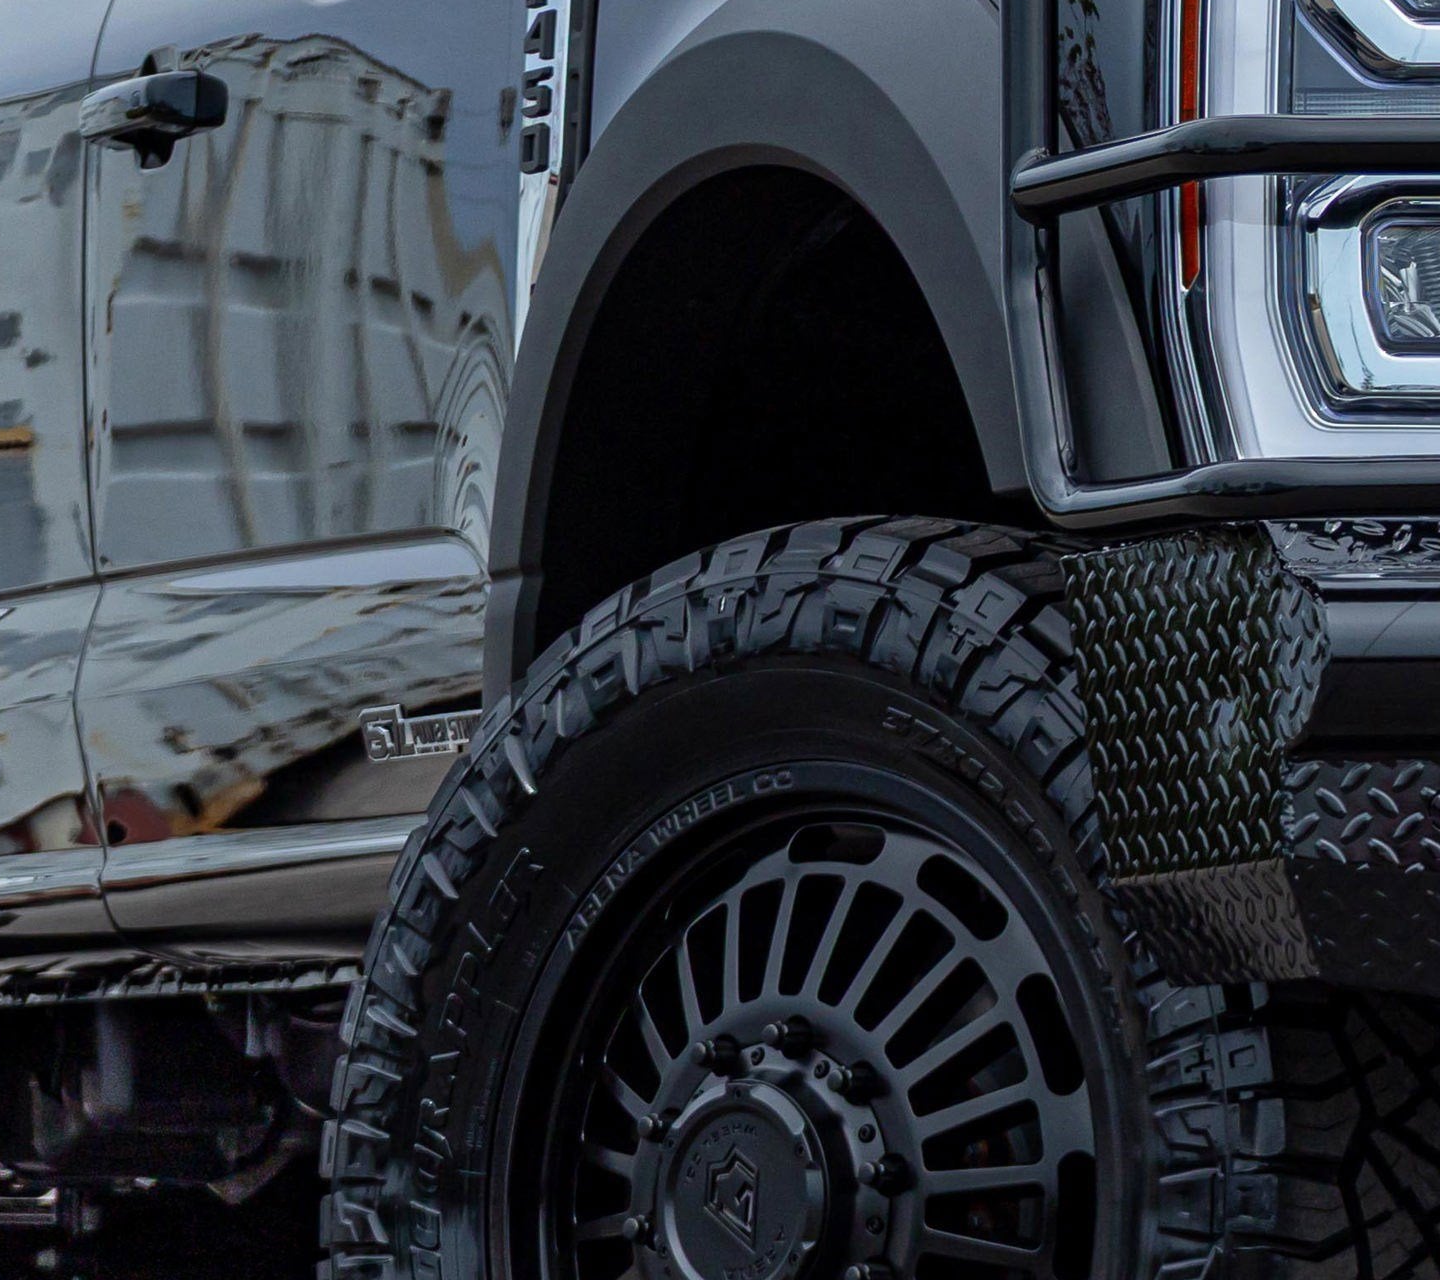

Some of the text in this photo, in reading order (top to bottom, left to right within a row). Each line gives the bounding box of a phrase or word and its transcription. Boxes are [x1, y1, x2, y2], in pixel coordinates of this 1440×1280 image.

[562, 844, 644, 956] ARENA
[648, 781, 747, 850] WHEEL
[751, 765, 795, 797] CO
